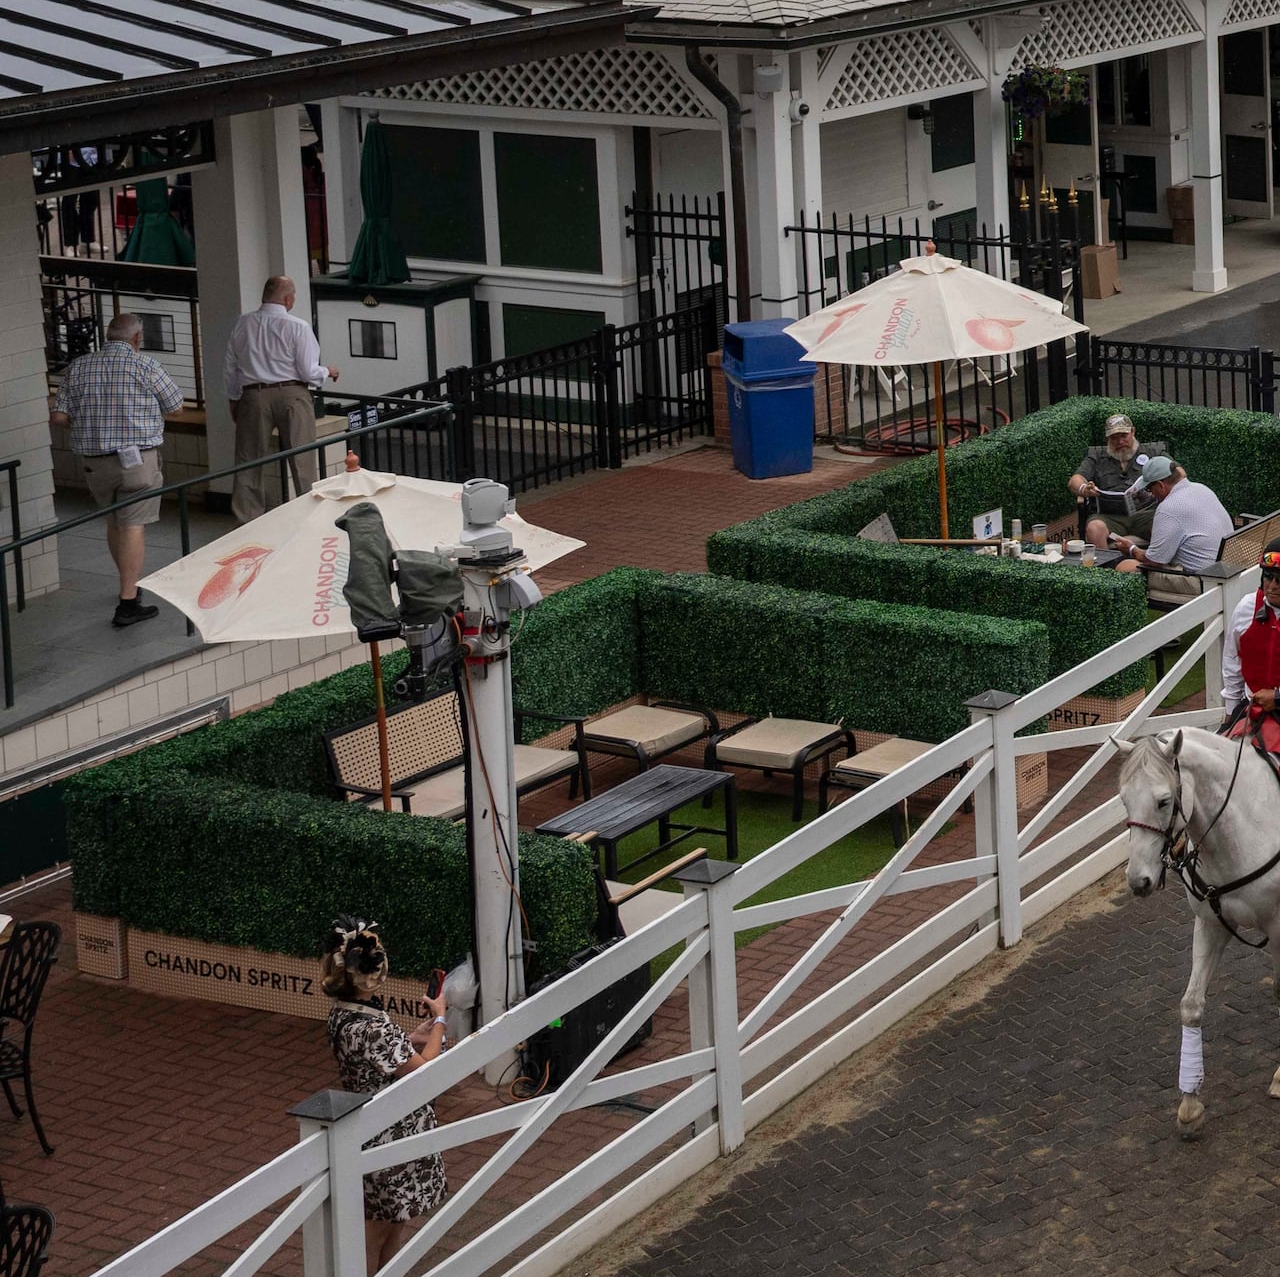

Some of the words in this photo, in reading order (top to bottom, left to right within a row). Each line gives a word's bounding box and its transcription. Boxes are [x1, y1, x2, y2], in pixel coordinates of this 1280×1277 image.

[874, 298, 908, 359] CHANDON
[312, 536, 338, 627] CHANDON
[144, 950, 241, 983] CHANDON
[247, 968, 314, 996] SPRITZ
